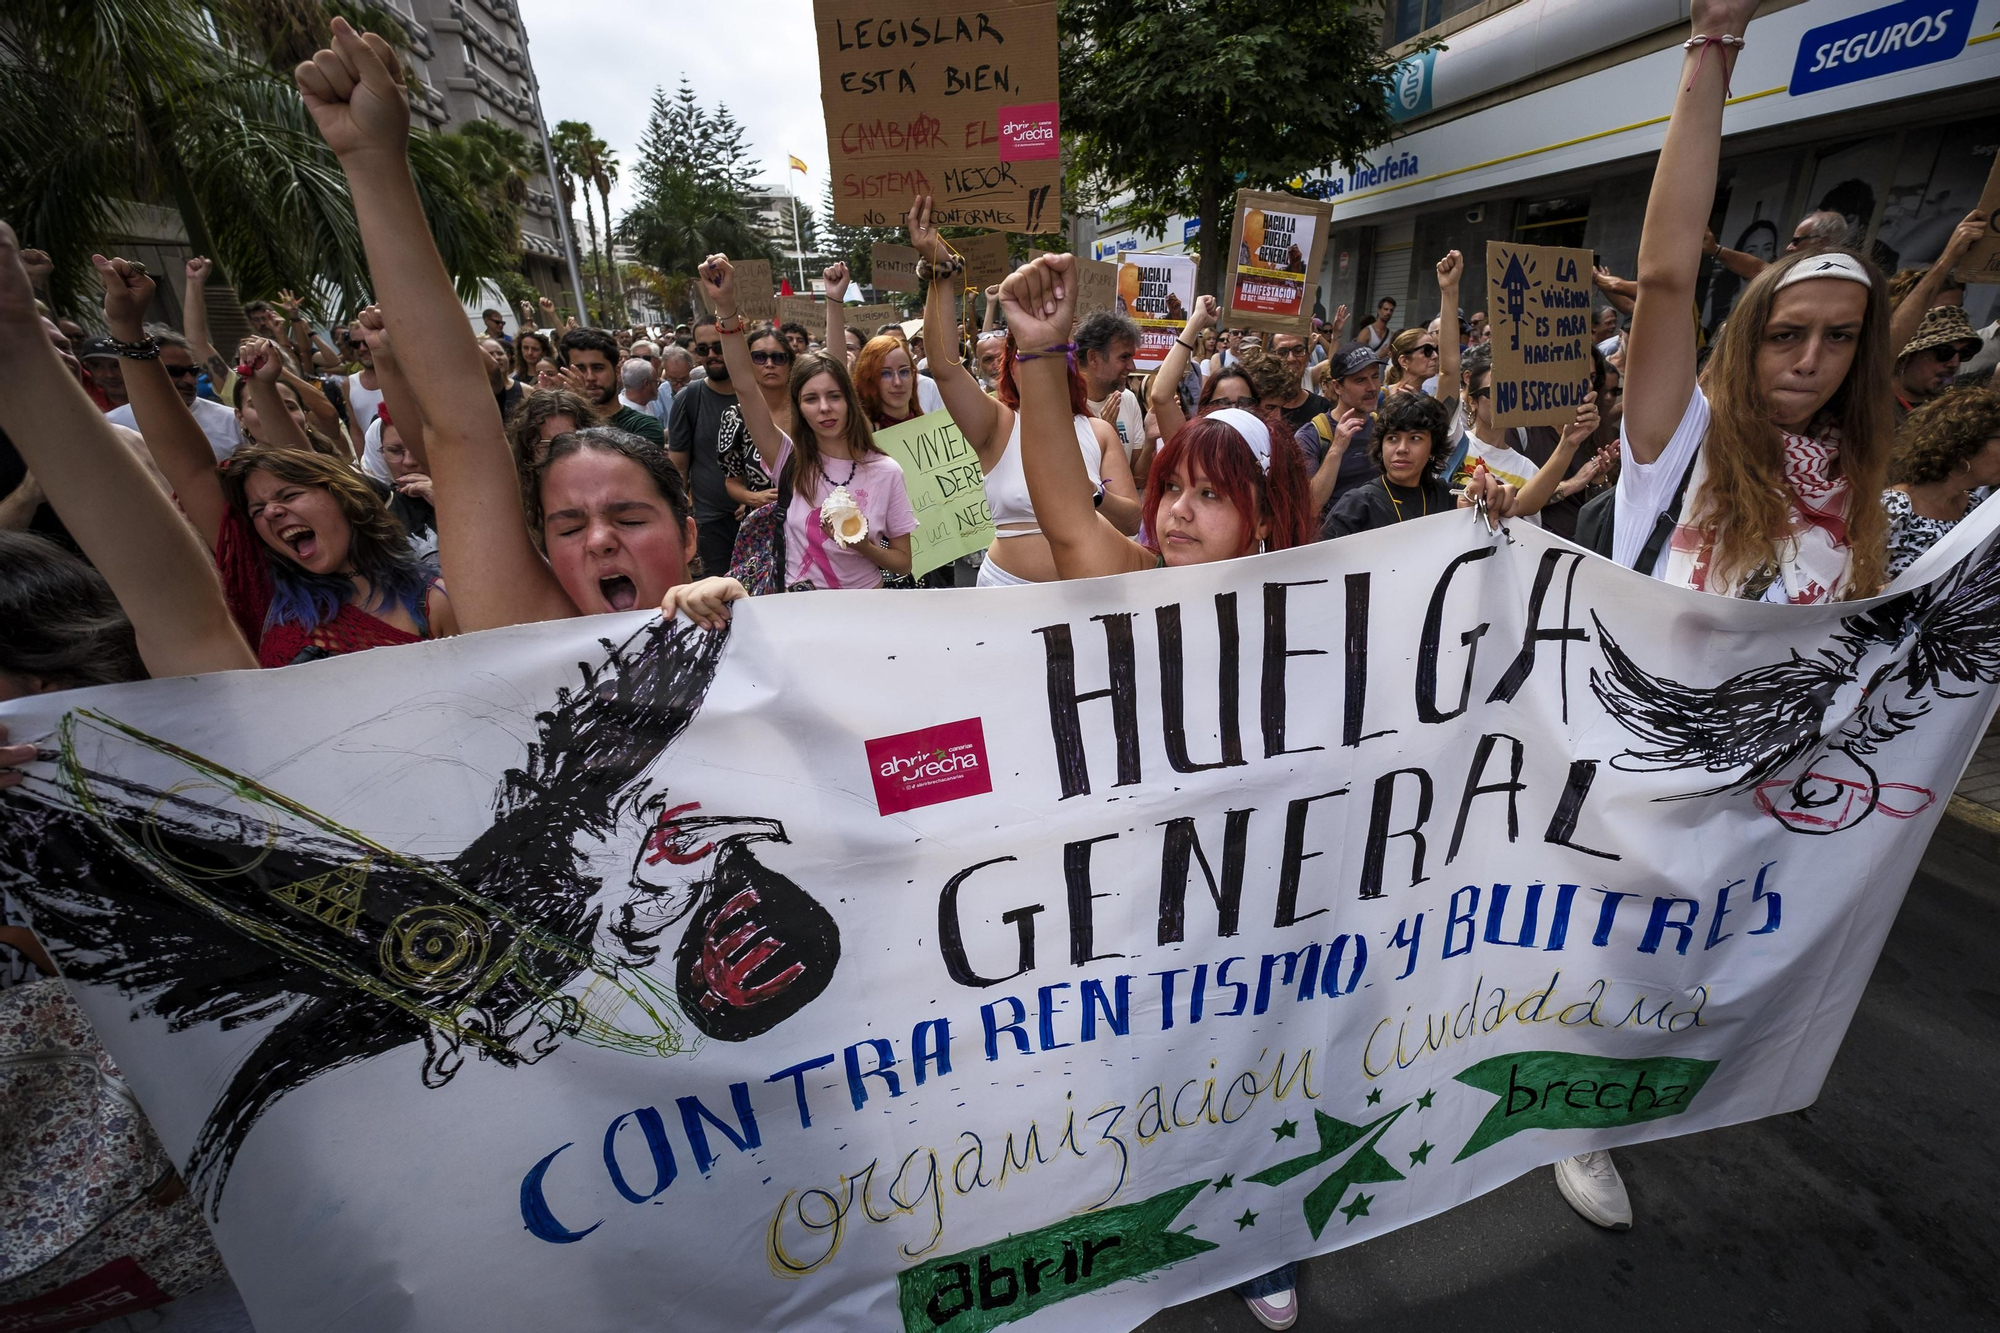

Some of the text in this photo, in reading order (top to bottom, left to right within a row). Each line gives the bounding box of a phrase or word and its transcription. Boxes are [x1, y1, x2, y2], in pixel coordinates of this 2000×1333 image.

[837, 13, 1004, 51] LEGISLAR
[1809, 9, 1953, 72] SEGUROS
[840, 61, 916, 95] ESTÁ
[965, 121, 998, 148] EL
[863, 209, 886, 226] NO
[929, 209, 1016, 225] CONFORMES
[1263, 213, 1296, 233] HACIA LA
[1264, 230, 1292, 248] HUELGA
[1259, 246, 1289, 265] GENERAL
[1555, 257, 1577, 283] LA
[1137, 266, 1171, 283] HACIA LA
[1138, 282, 1168, 297] HUELGA
[1135, 298, 1168, 313] GENERAL
[1241, 283, 1297, 300] MANIFESTACIÓN
[1535, 315, 1587, 337] ES PARA
[1496, 378, 1589, 414] NO ESPECULAR
[1119, 431, 1130, 444] RL
[935, 460, 984, 499] DERE
[955, 499, 991, 530] NEG
[1031, 546, 1590, 801] HUELGA
[880, 743, 973, 777] abrir canarias
[938, 733, 1622, 988] GENERAL
[1362, 966, 1711, 1082] ciudadana
[520, 1016, 955, 1245] CONTRA
[981, 933, 1368, 1062] RENTISMO
[1442, 862, 1782, 960] BUITRES
[1505, 1063, 1692, 1118] brecha
[926, 1236, 1121, 1325] abrir
